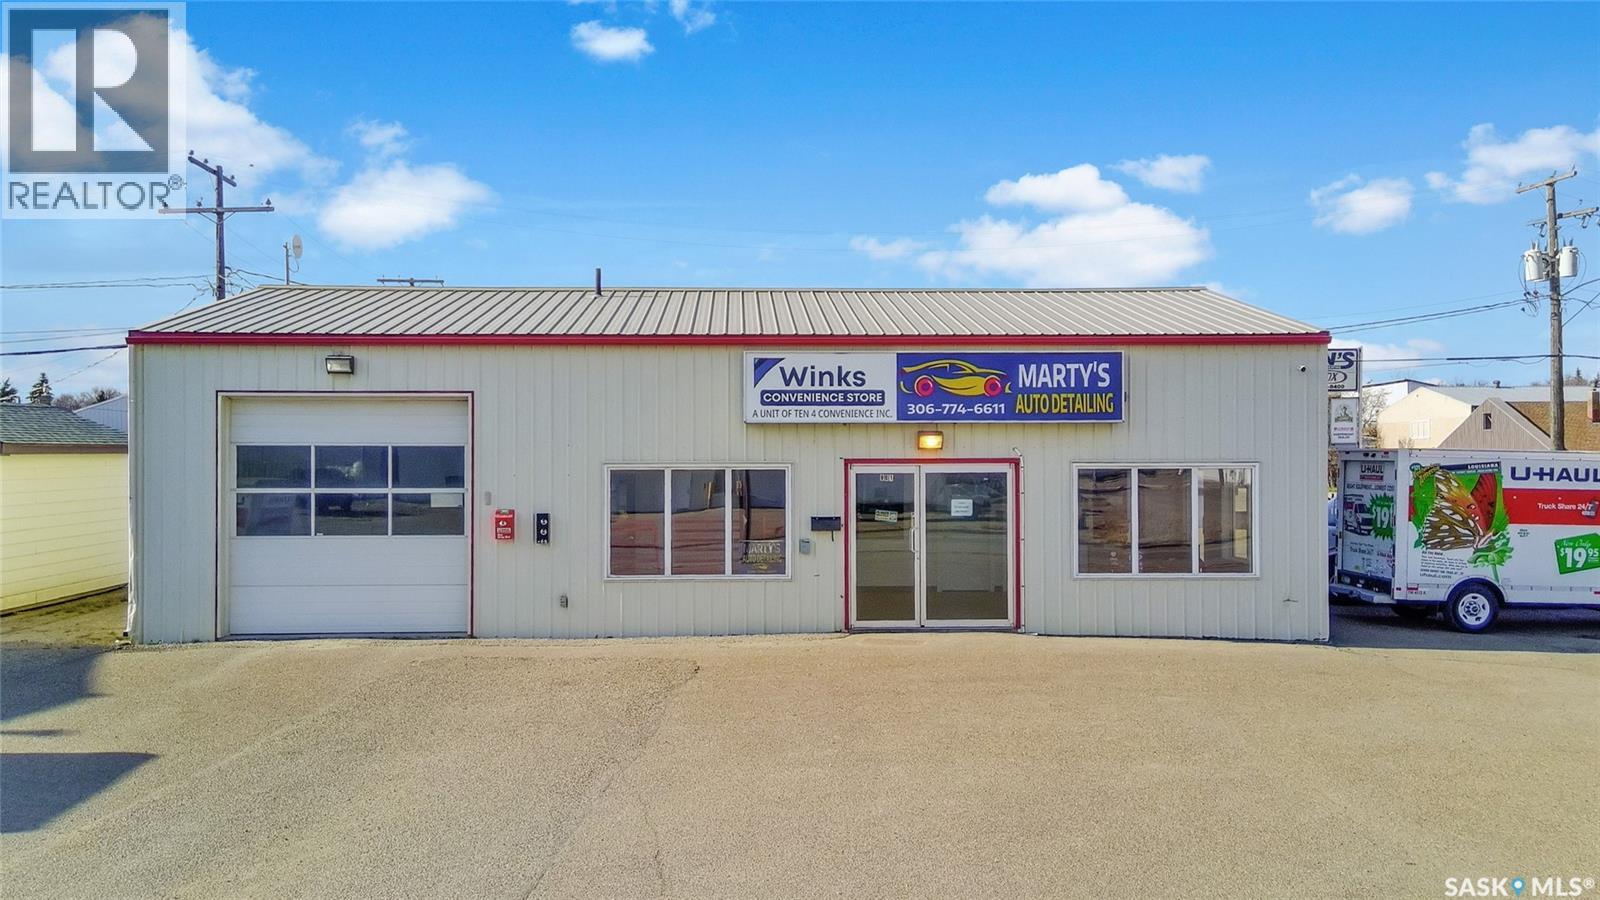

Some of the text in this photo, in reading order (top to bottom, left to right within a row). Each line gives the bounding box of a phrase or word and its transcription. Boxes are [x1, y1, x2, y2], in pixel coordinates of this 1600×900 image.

[779, 365, 866, 387] Winks
[1018, 361, 1110, 388] MARTY'S
[763, 392, 883, 402] CONVENIENCE STORE
[1015, 393, 1114, 413] AUTO DETAILING
[752, 409, 893, 418] A UNIT OF TEN 4 CONVENIENCE INC.
[907, 403, 1005, 415] 306-774-6611
[1511, 466, 1600, 482] U-HAUL
[1577, 503, 1592, 512] 24/7
